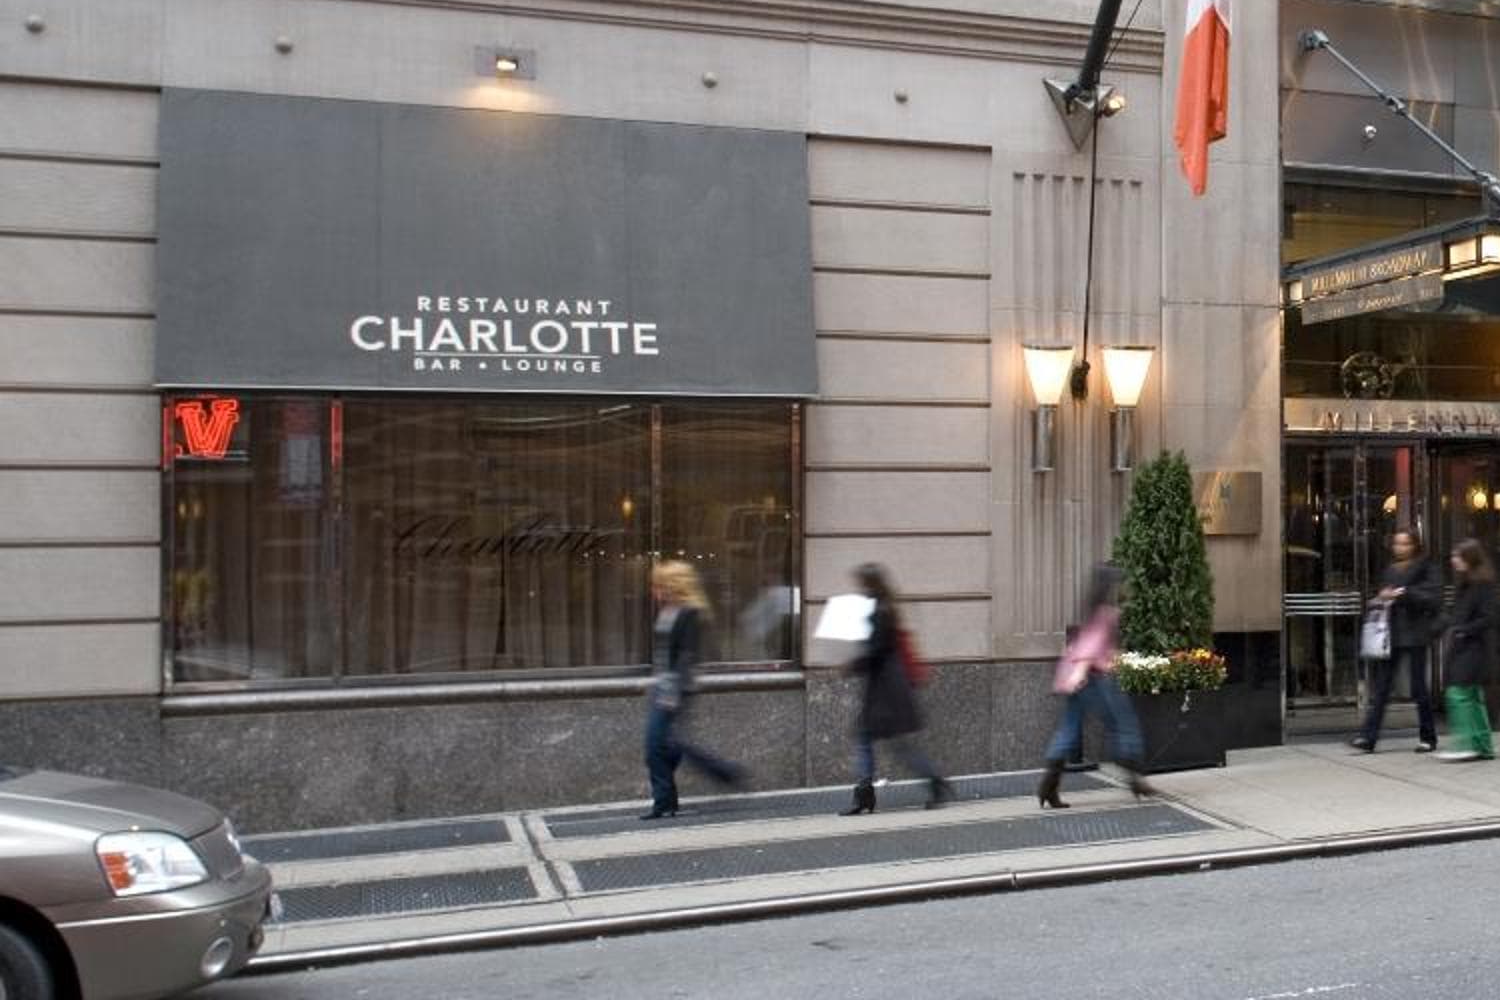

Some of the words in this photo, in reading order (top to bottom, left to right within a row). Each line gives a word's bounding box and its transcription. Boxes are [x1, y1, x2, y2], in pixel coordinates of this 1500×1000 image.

[417, 296, 611, 315] RESTAURANT
[350, 315, 660, 355] CHARLOTTE
[413, 358, 462, 372] BAR
[501, 359, 602, 374] LOUNGE
